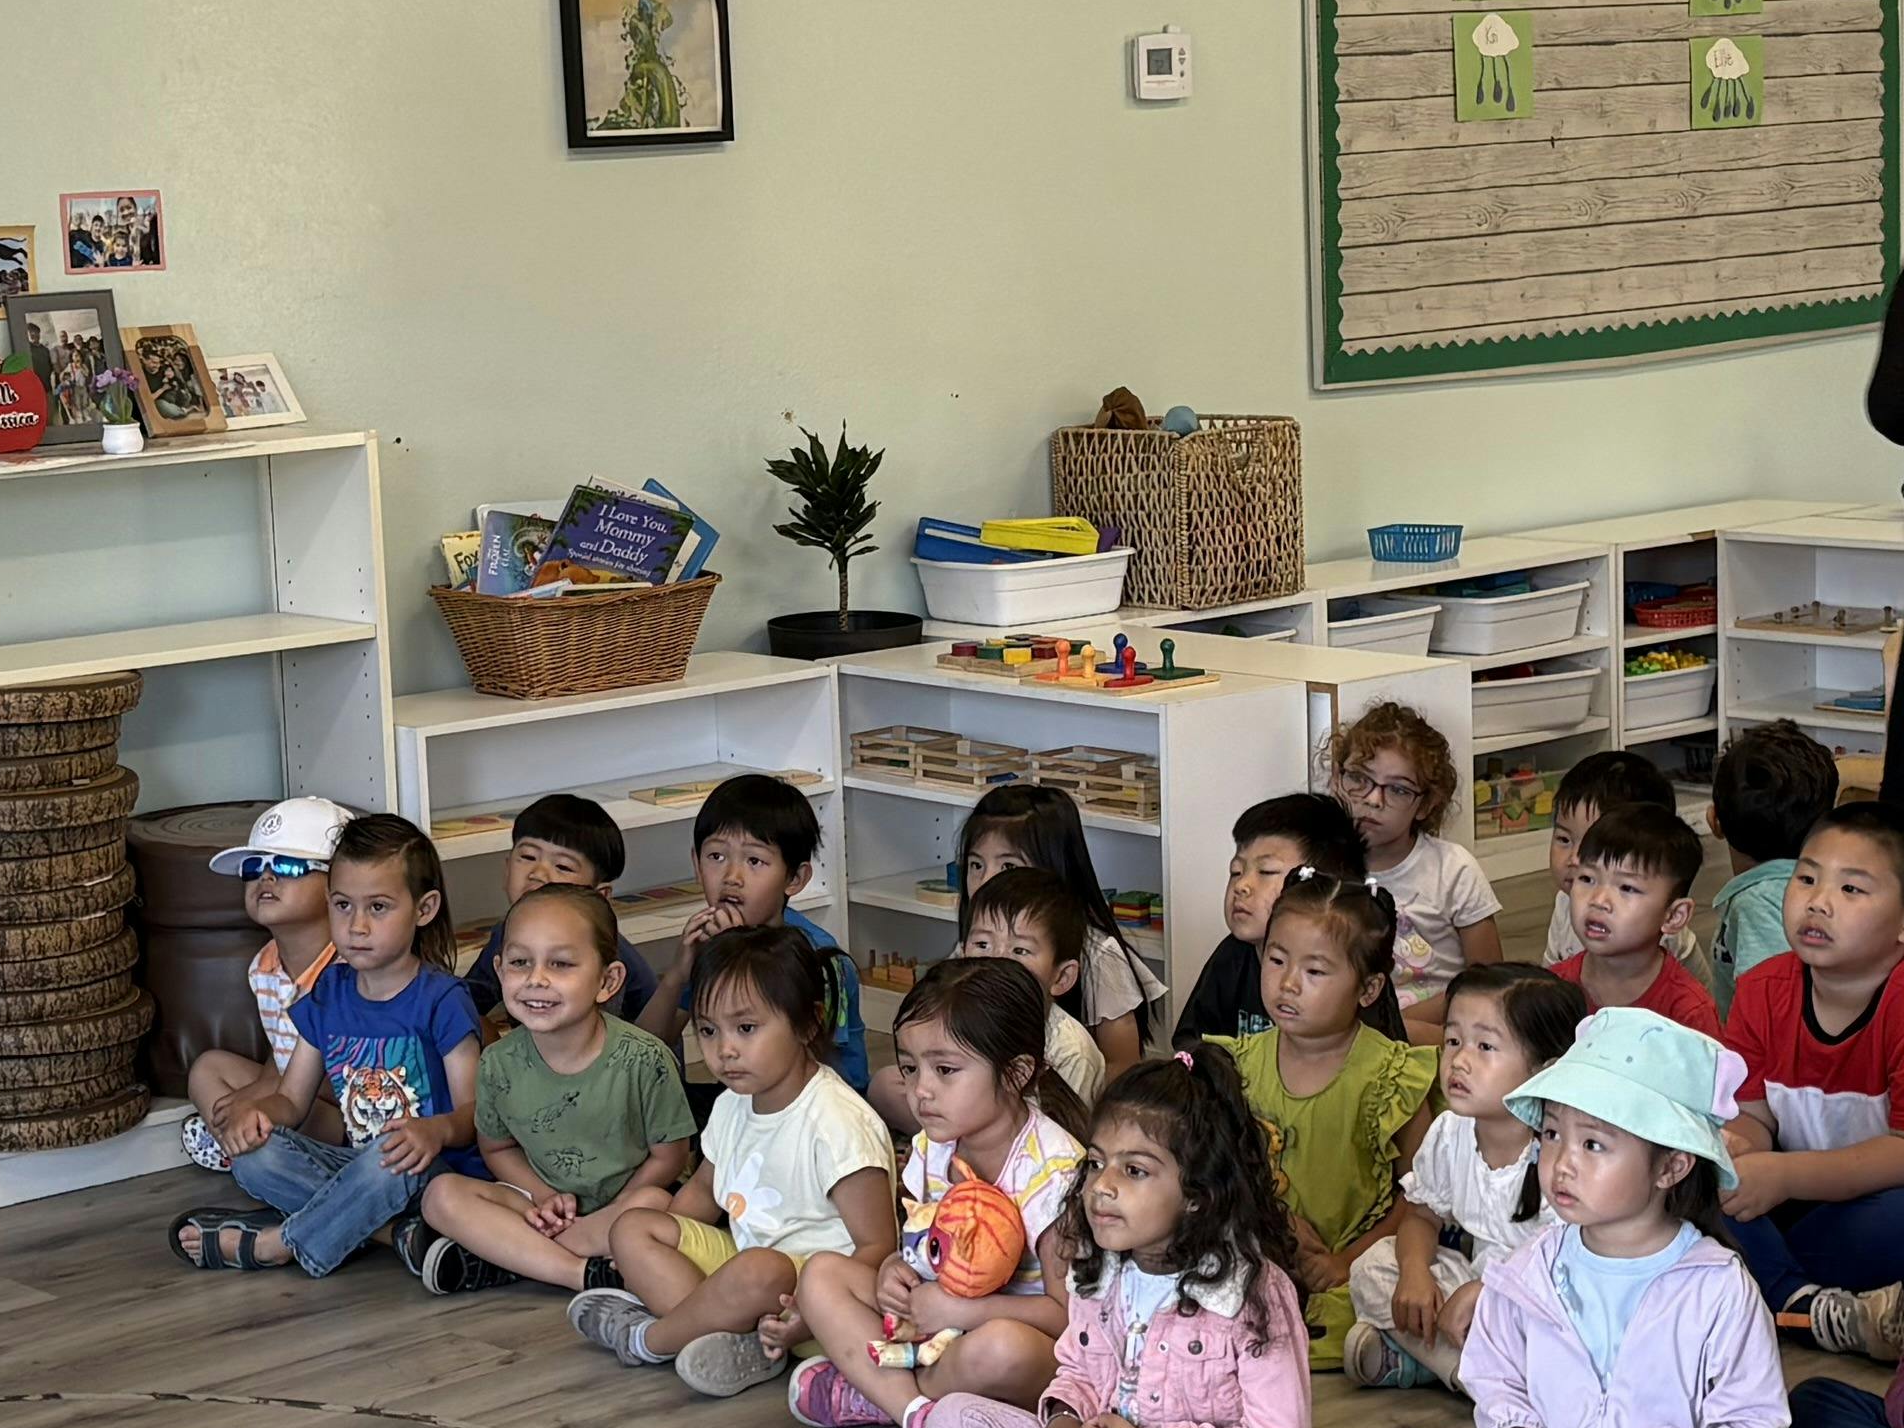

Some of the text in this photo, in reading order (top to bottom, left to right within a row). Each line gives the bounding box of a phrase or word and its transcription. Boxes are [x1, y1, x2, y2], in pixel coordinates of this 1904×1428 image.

[599, 504, 607, 516] I
[610, 506, 639, 525] Love
[594, 518, 656, 548] Mommy
[455, 551, 479, 573] Fox
[597, 541, 649, 565] Daddy
